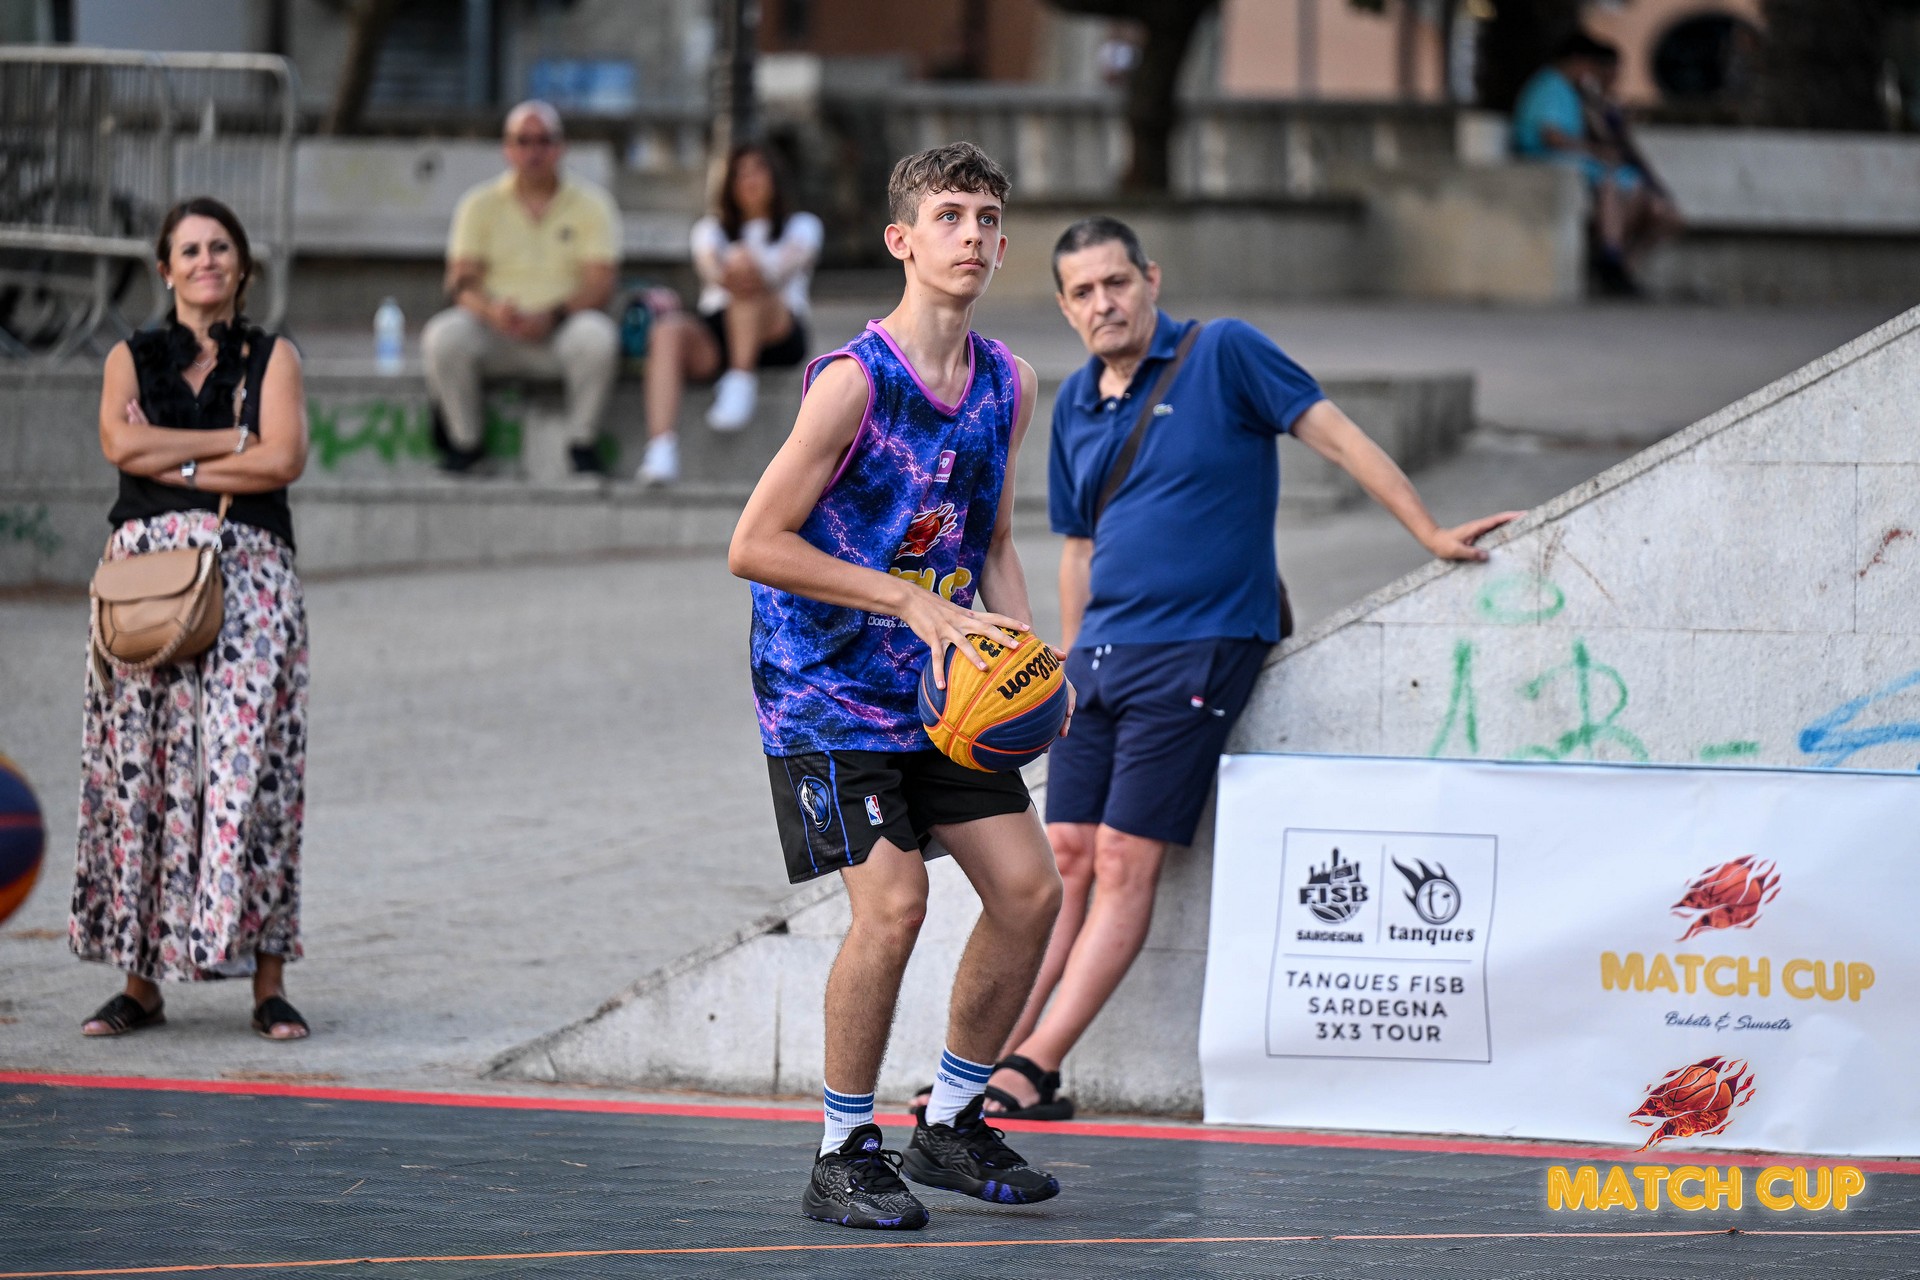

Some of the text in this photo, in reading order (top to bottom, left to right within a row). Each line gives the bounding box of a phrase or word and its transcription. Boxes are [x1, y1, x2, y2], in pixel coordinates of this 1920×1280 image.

[997, 645, 1060, 700] Wilson
[1299, 885, 1368, 904] FISB
[1389, 925, 1475, 945] tanques
[1287, 971, 1464, 994] TANQUES FISB
[1600, 951, 1875, 1002] MATCH CUP
[1308, 997, 1448, 1018] SARDEGNA
[1316, 1022, 1442, 1042] 3X3 TOUR
[1714, 1012, 1730, 1033] &
